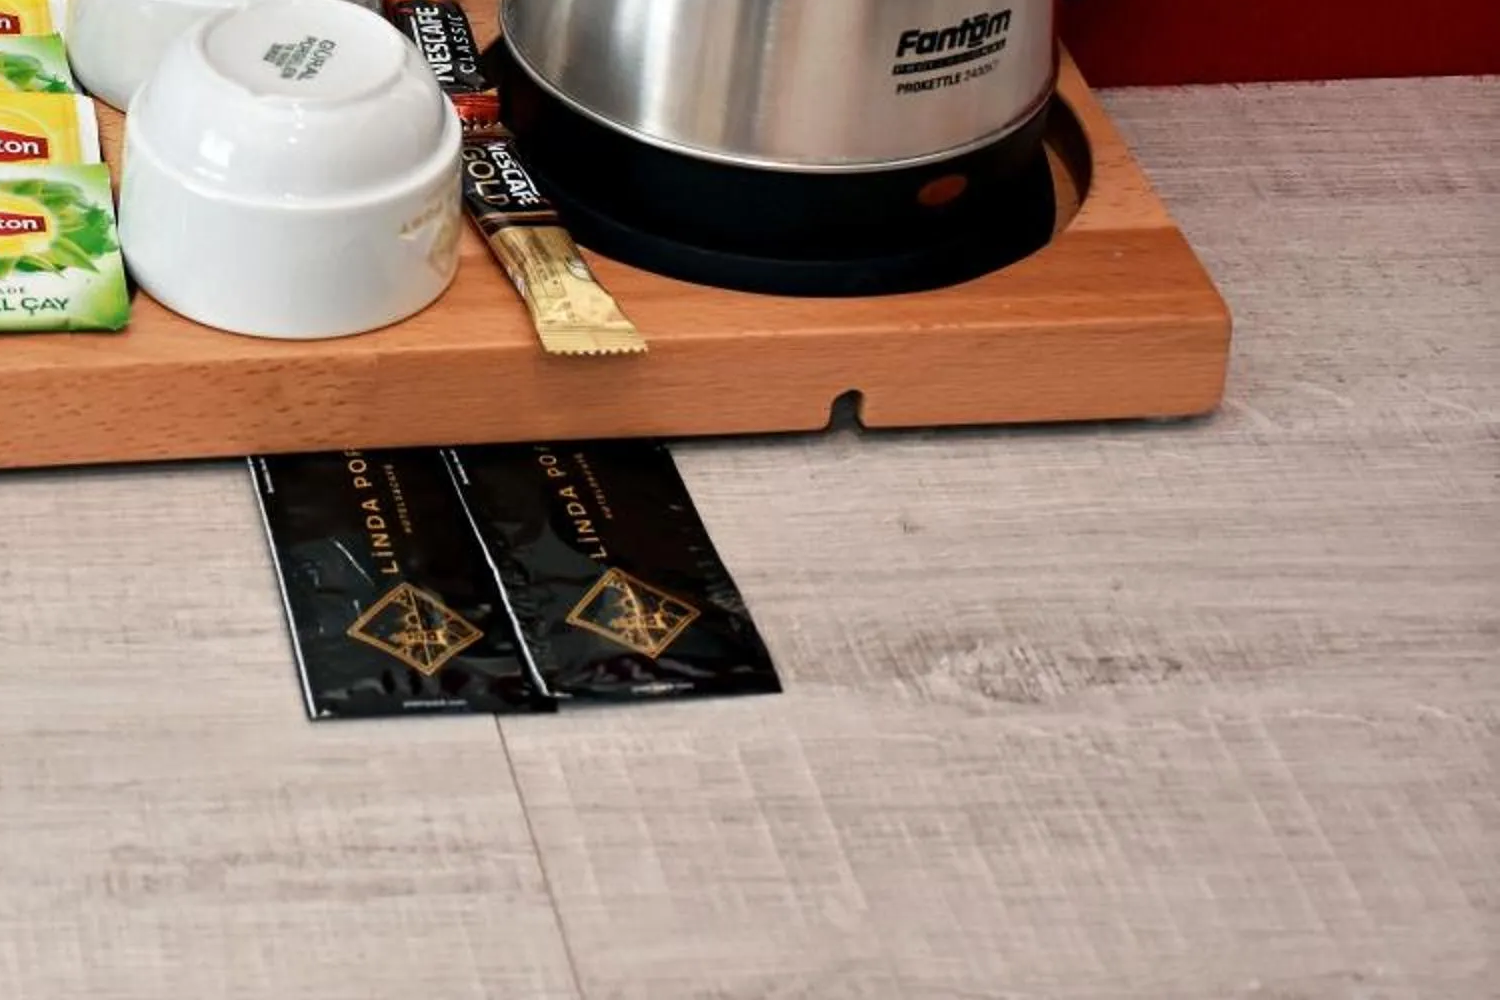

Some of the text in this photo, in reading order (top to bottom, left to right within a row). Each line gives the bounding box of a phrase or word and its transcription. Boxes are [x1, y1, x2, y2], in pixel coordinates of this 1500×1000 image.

[447, 13, 477, 74] CLASSIC
[895, 71, 962, 96] PROKETTLE
[461, 146, 510, 206] GOLD
[21, 297, 71, 316] ÇAY
[533, 445, 567, 477] PO
[361, 498, 400, 574] LINDA
[559, 485, 608, 559] LINDA
